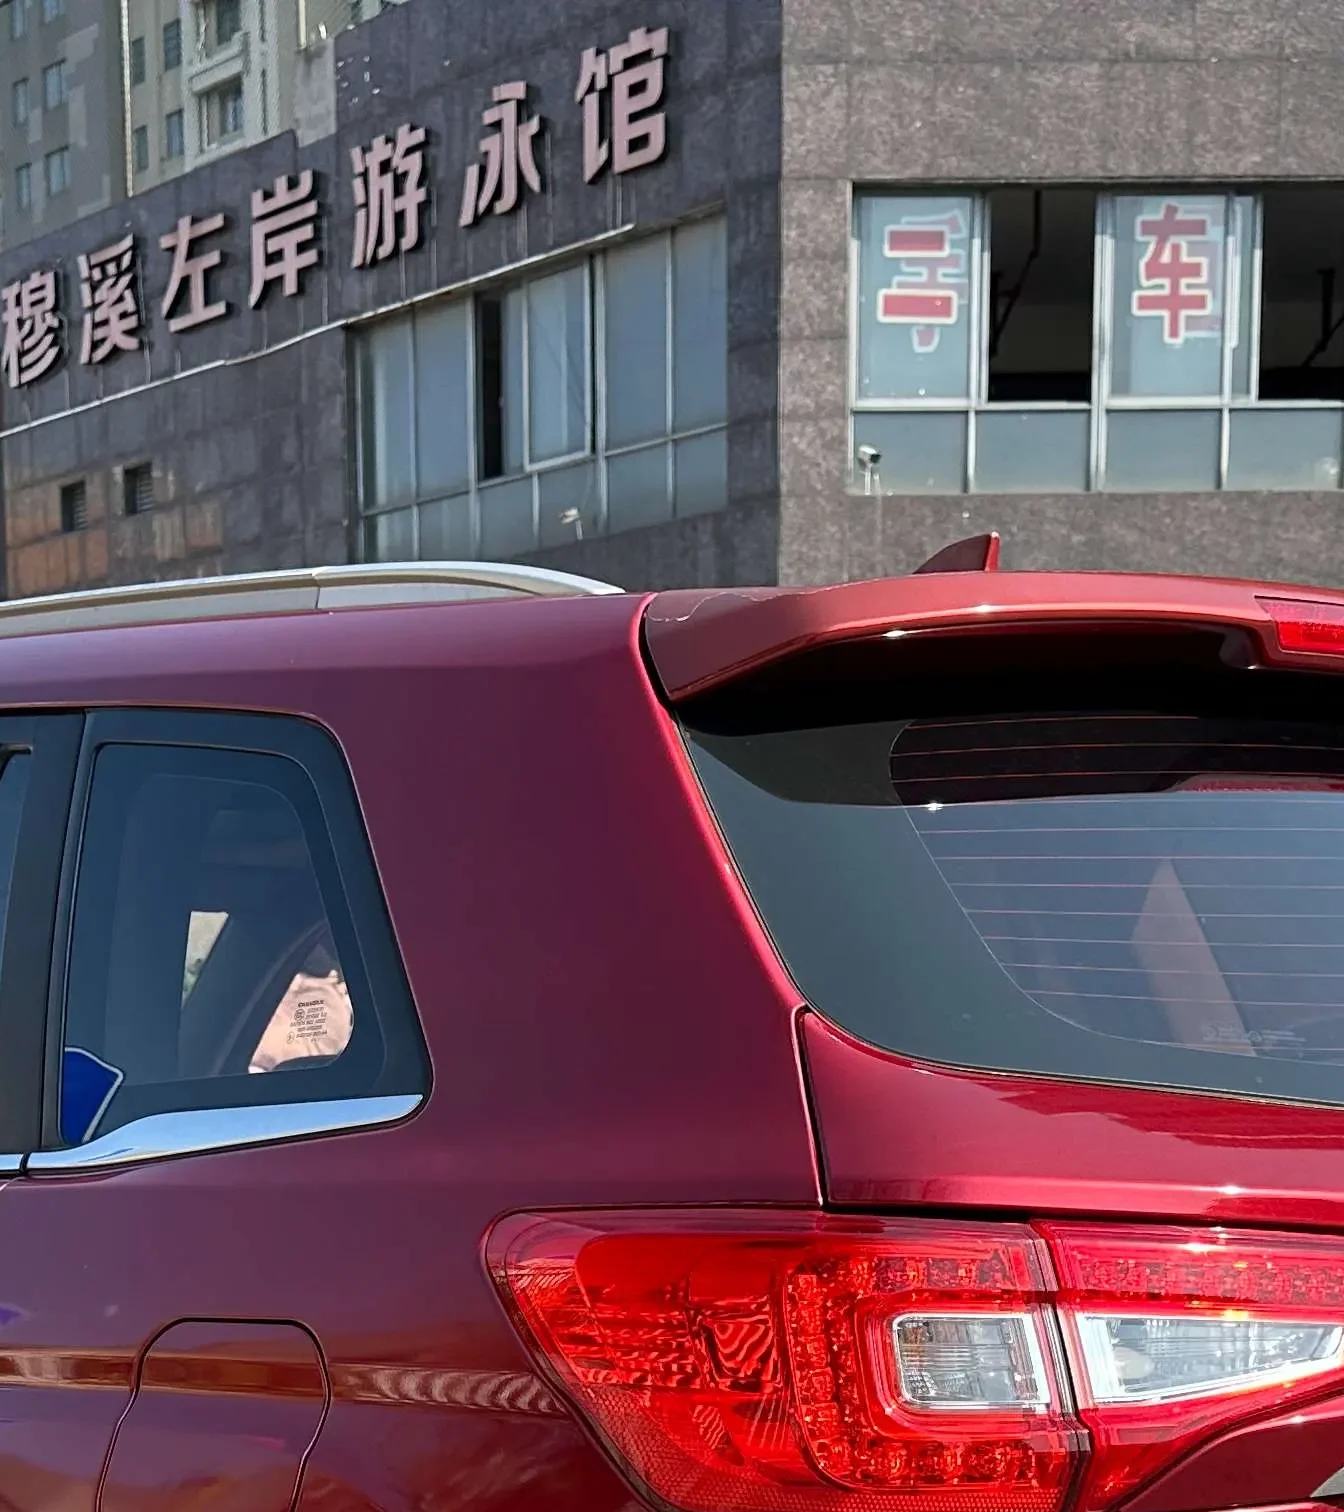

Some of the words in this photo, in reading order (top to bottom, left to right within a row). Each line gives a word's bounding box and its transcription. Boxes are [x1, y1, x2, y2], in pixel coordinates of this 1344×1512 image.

[0, 26, 670, 389] 穆溪左岸游泳馆
